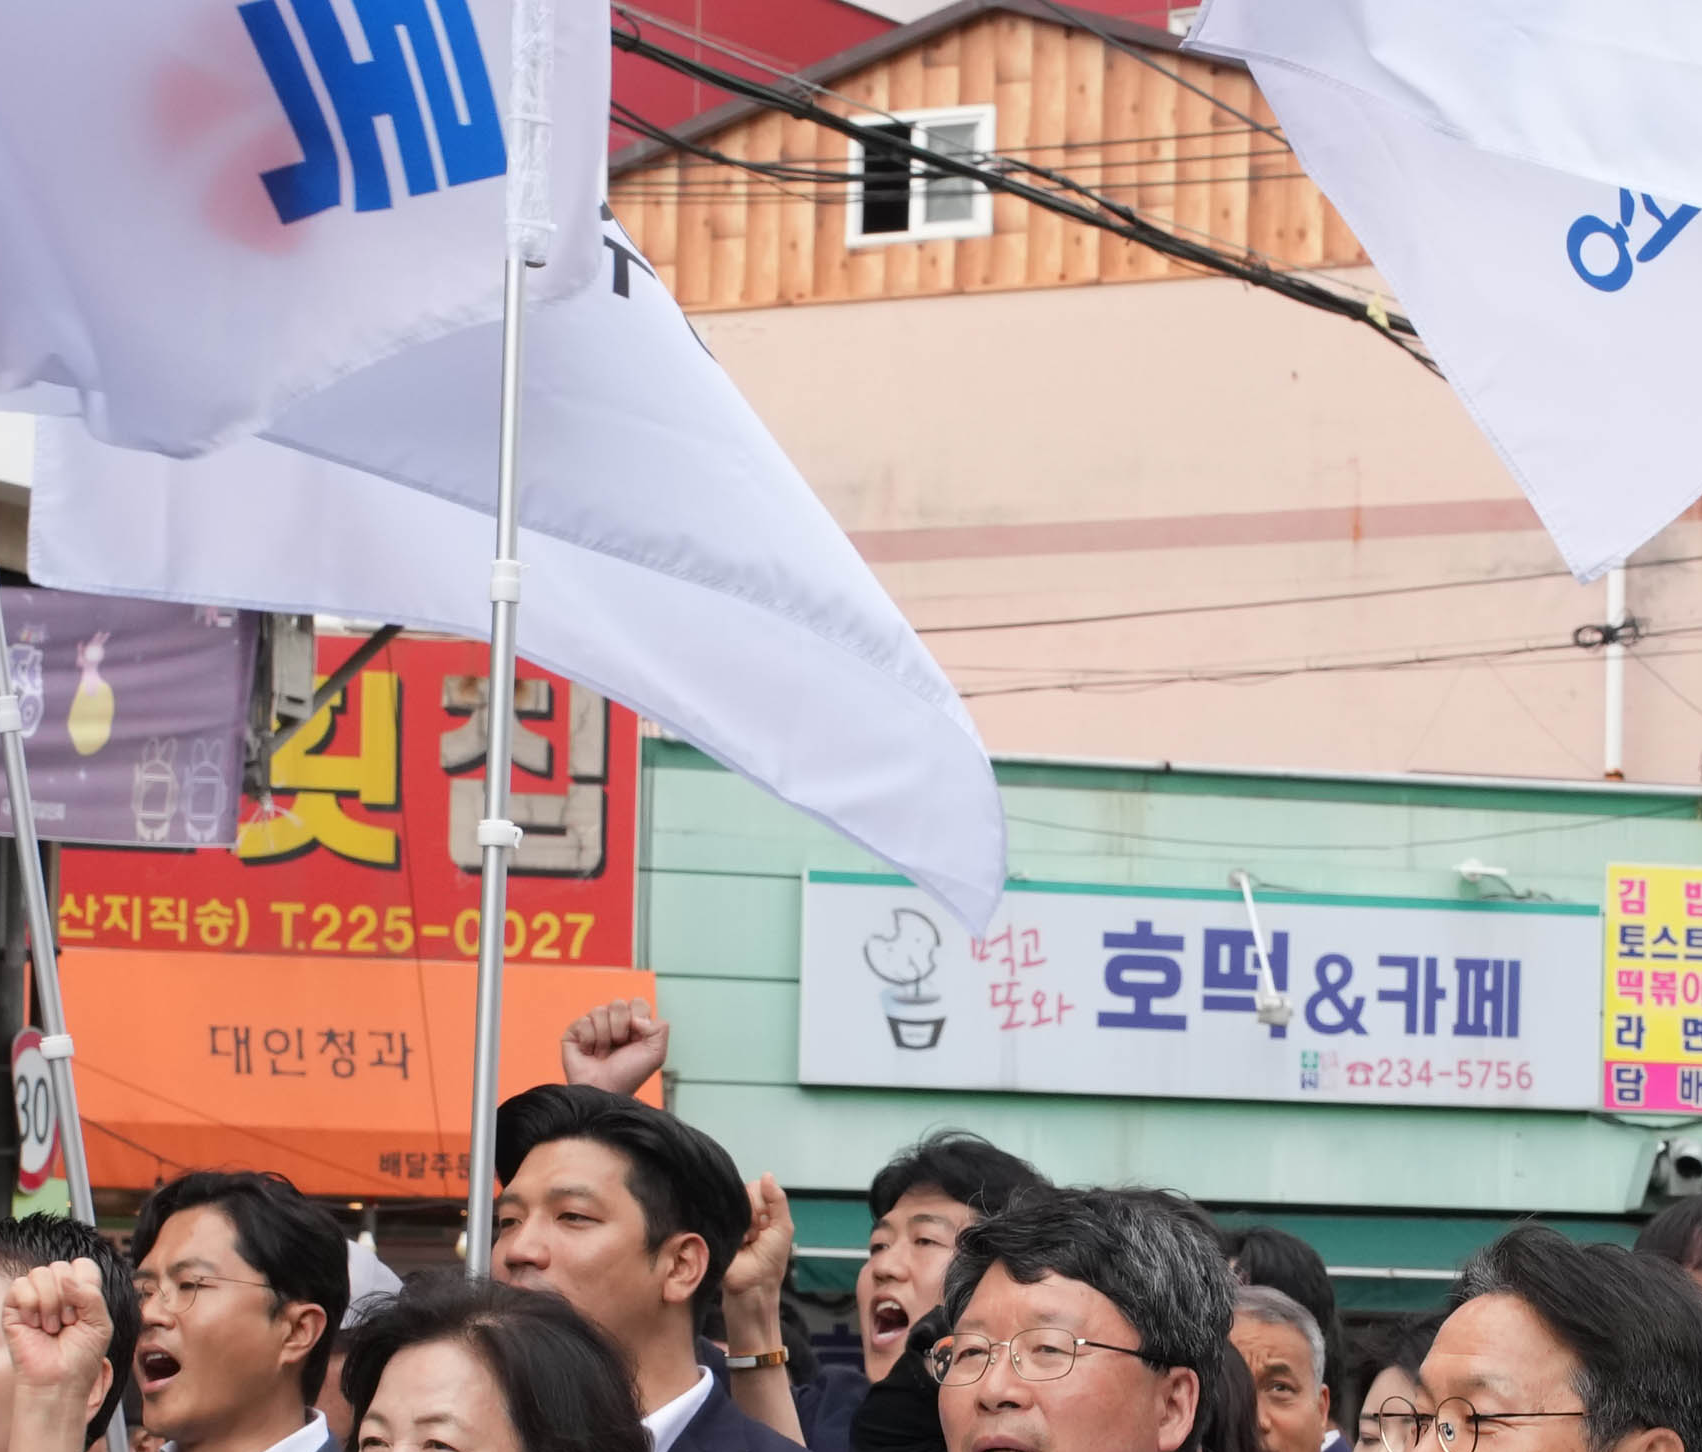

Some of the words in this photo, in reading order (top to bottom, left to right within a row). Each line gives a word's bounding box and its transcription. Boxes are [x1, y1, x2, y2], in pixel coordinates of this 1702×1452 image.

[970, 926, 1047, 972] 먹고
[990, 979, 1075, 1031] 또와
[209, 1025, 416, 1081] 대인청과
[1377, 1057, 1534, 1091] 234-5756
[15, 1075, 48, 1144] 30
